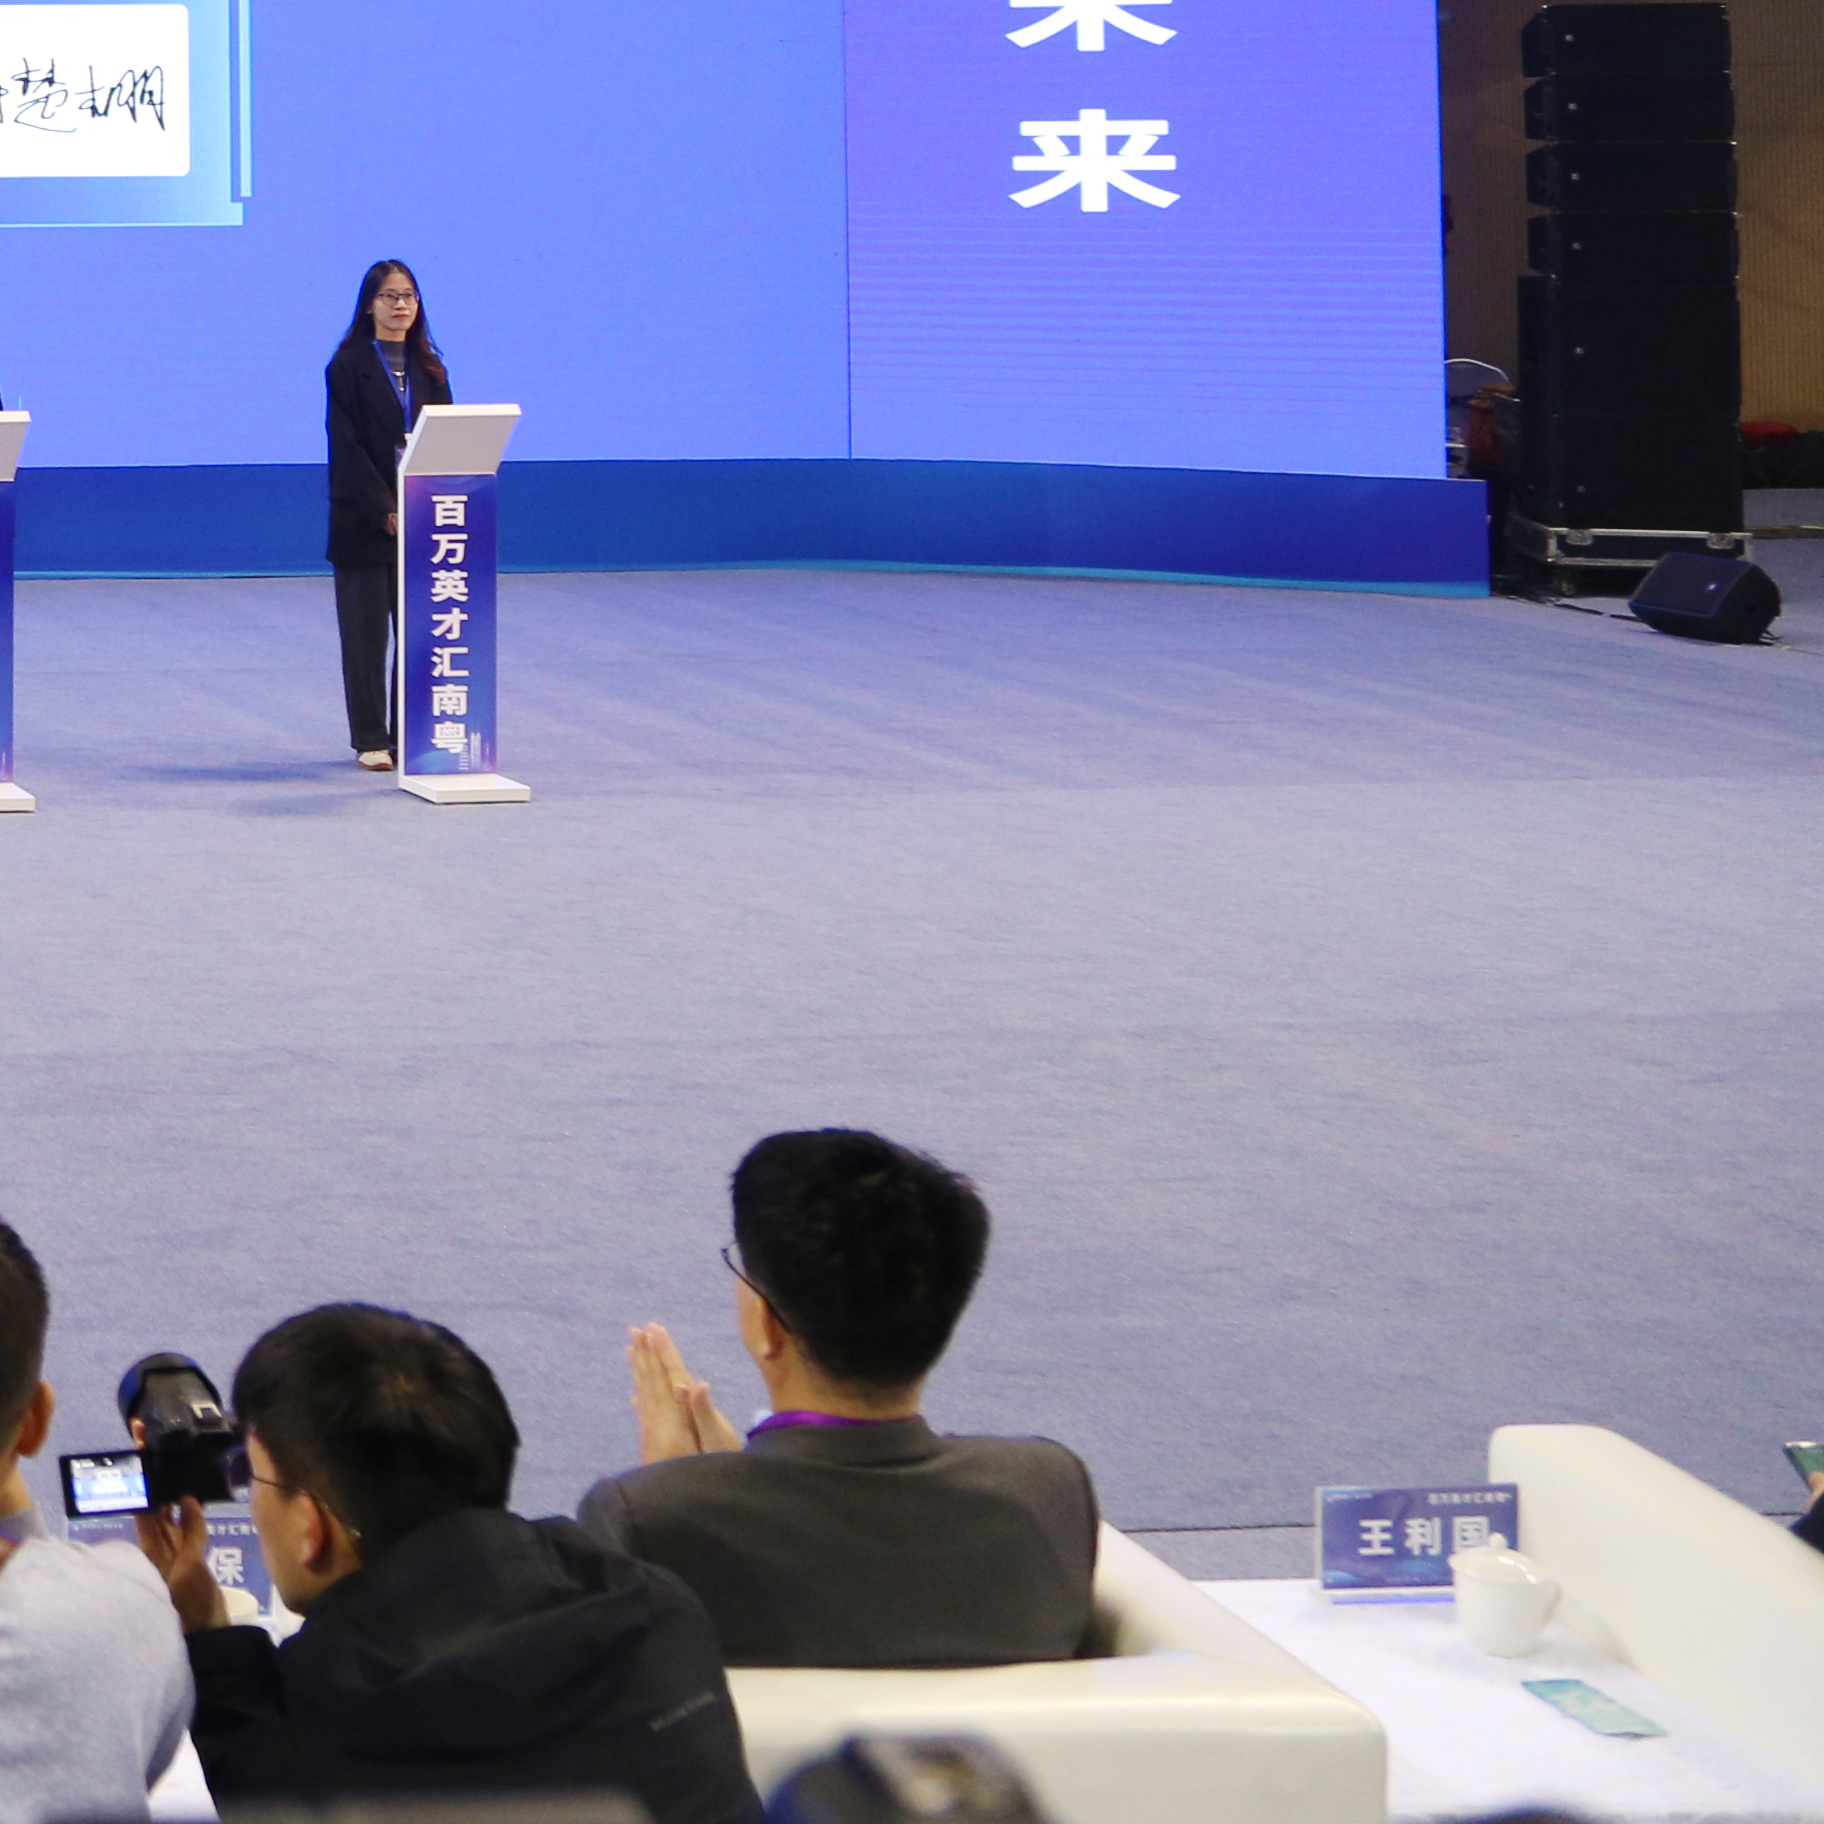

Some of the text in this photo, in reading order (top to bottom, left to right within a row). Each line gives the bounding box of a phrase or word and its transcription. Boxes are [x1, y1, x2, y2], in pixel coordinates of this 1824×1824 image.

[430, 494, 471, 756] 百万英才汇南粤
[1358, 1515, 1490, 1557] 王利国
